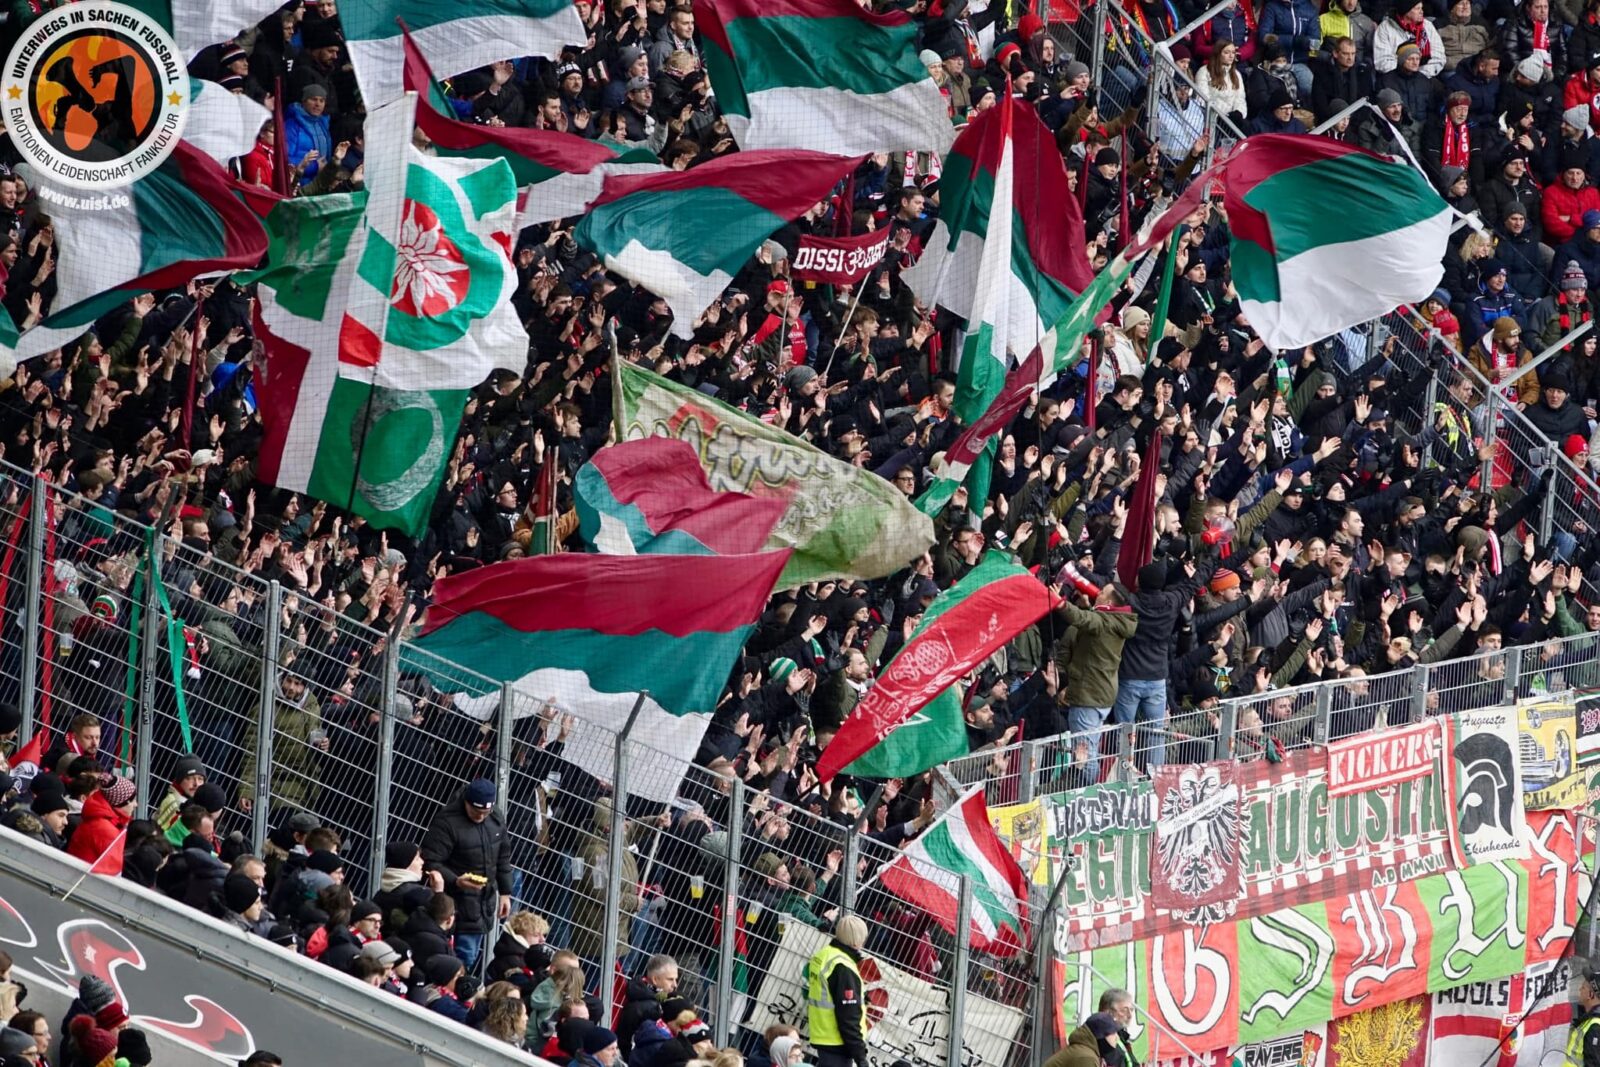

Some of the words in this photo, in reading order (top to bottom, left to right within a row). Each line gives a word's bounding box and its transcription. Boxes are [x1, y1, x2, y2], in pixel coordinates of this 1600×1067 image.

[792, 247, 846, 272] DISSI
[1461, 713, 1507, 730] Augusta
[1330, 730, 1434, 787] KICKERS
[1052, 785, 1152, 841] LUSTENAU
[1244, 1041, 1304, 1067] RAVERS
